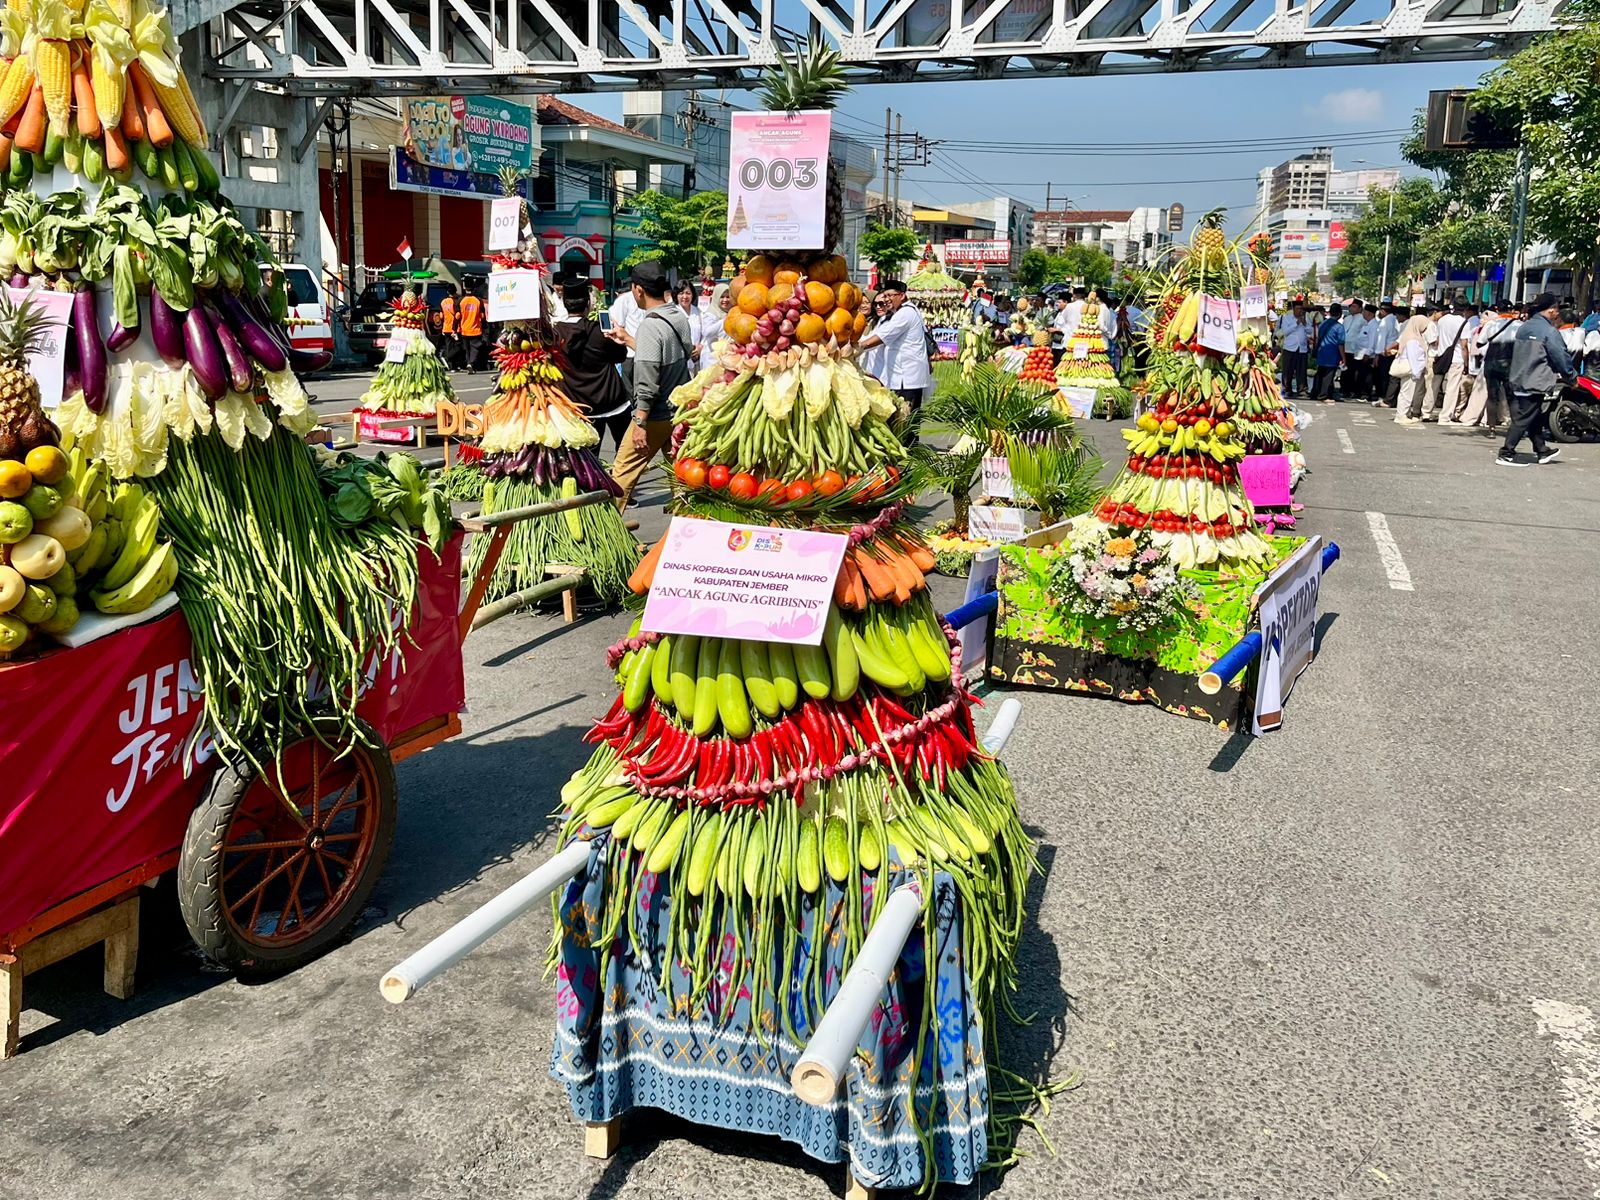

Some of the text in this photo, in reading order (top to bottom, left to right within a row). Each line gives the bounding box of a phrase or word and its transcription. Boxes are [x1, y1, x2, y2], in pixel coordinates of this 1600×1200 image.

[437, 104, 450, 123] TO
[464, 113, 490, 135] AGUNG
[469, 134, 489, 146] GROSIR
[759, 129, 781, 137] ANCAK
[739, 158, 818, 191] 003
[494, 216, 516, 228] 007
[1202, 313, 1233, 331] 005
[985, 471, 1008, 480] 006
[663, 562, 827, 583] DINAS KOPERASI DAN USAHA MIKRO
[693, 576, 788, 592] KABUPATEN JEMBER
[704, 590, 749, 604] AGUNG
